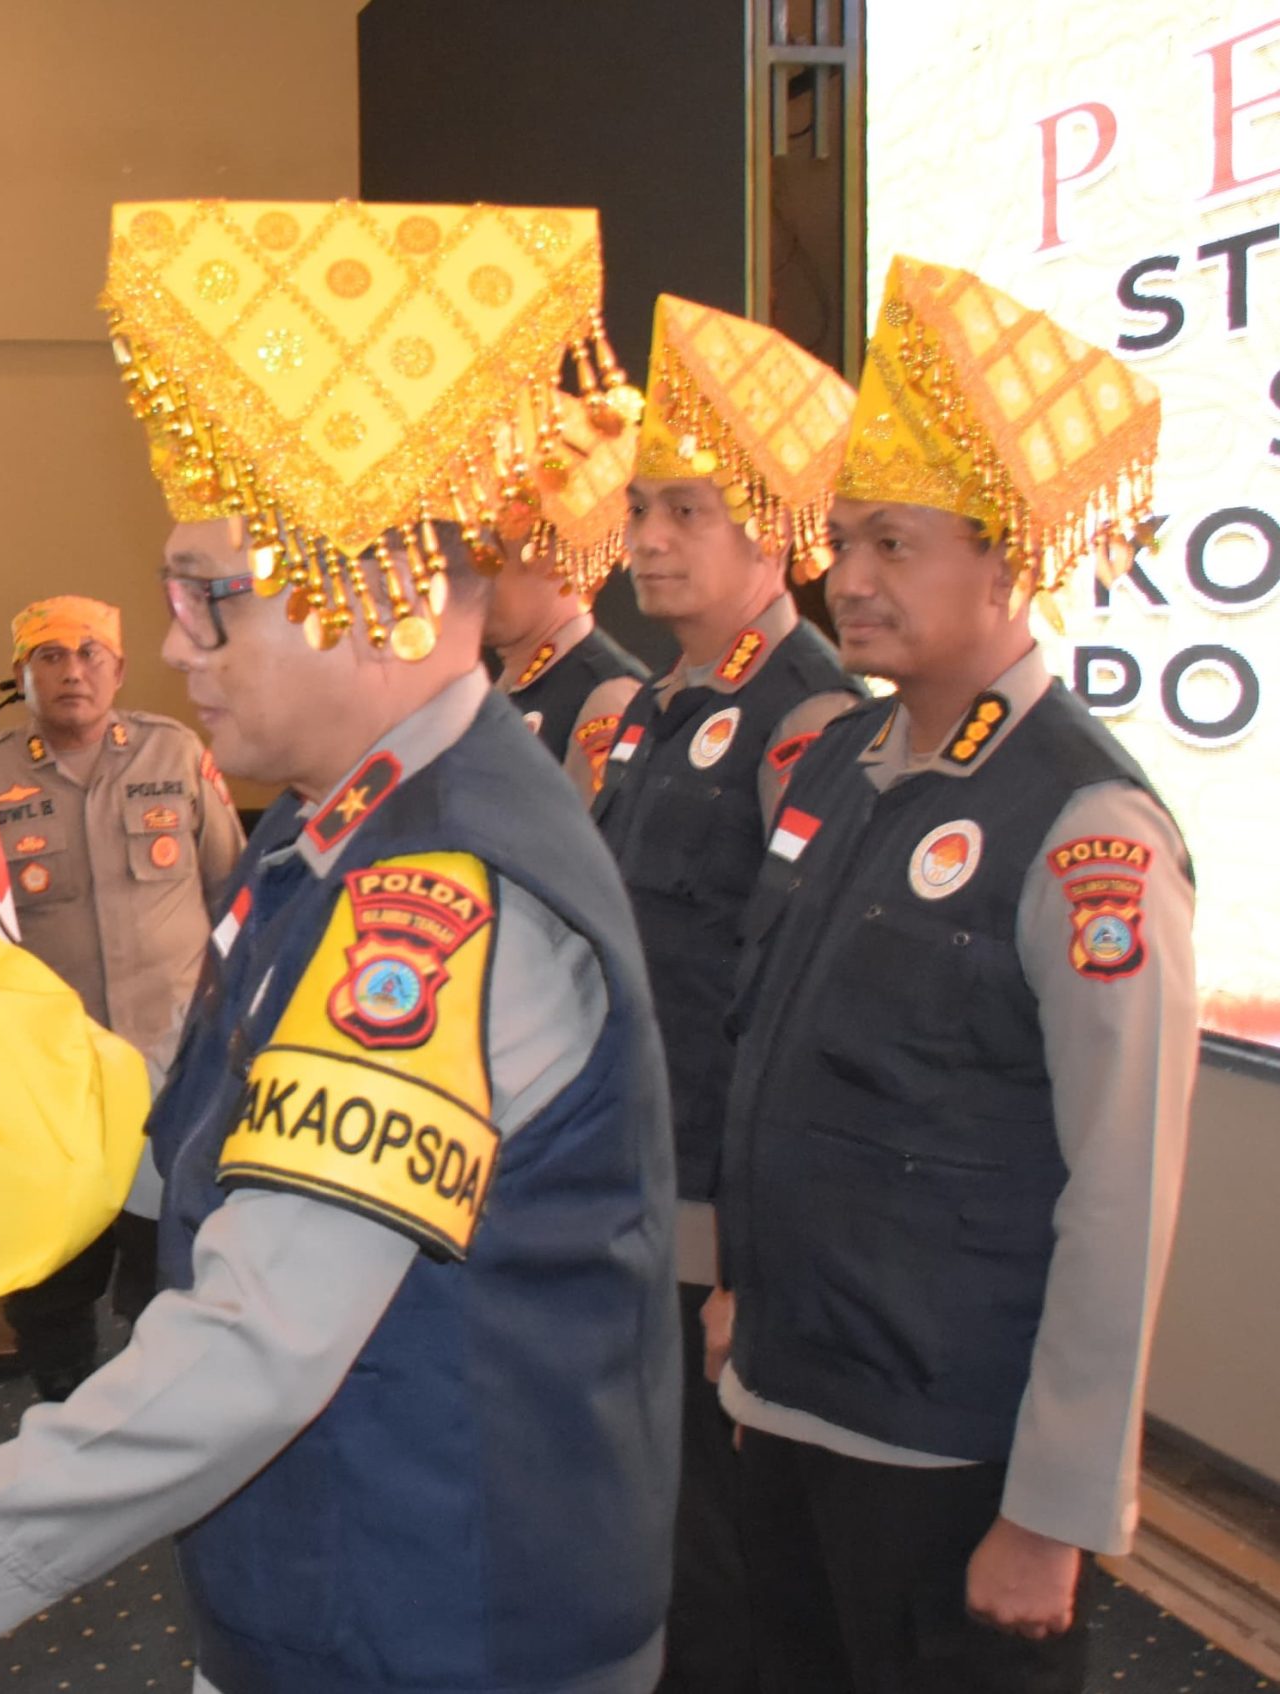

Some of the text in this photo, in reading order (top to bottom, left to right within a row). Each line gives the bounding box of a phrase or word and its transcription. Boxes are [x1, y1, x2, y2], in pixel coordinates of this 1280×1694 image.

[1116, 223, 1280, 351] ST
[576, 717, 619, 741] POLD
[1055, 840, 1144, 869] POLDA
[359, 874, 473, 921] POLDA
